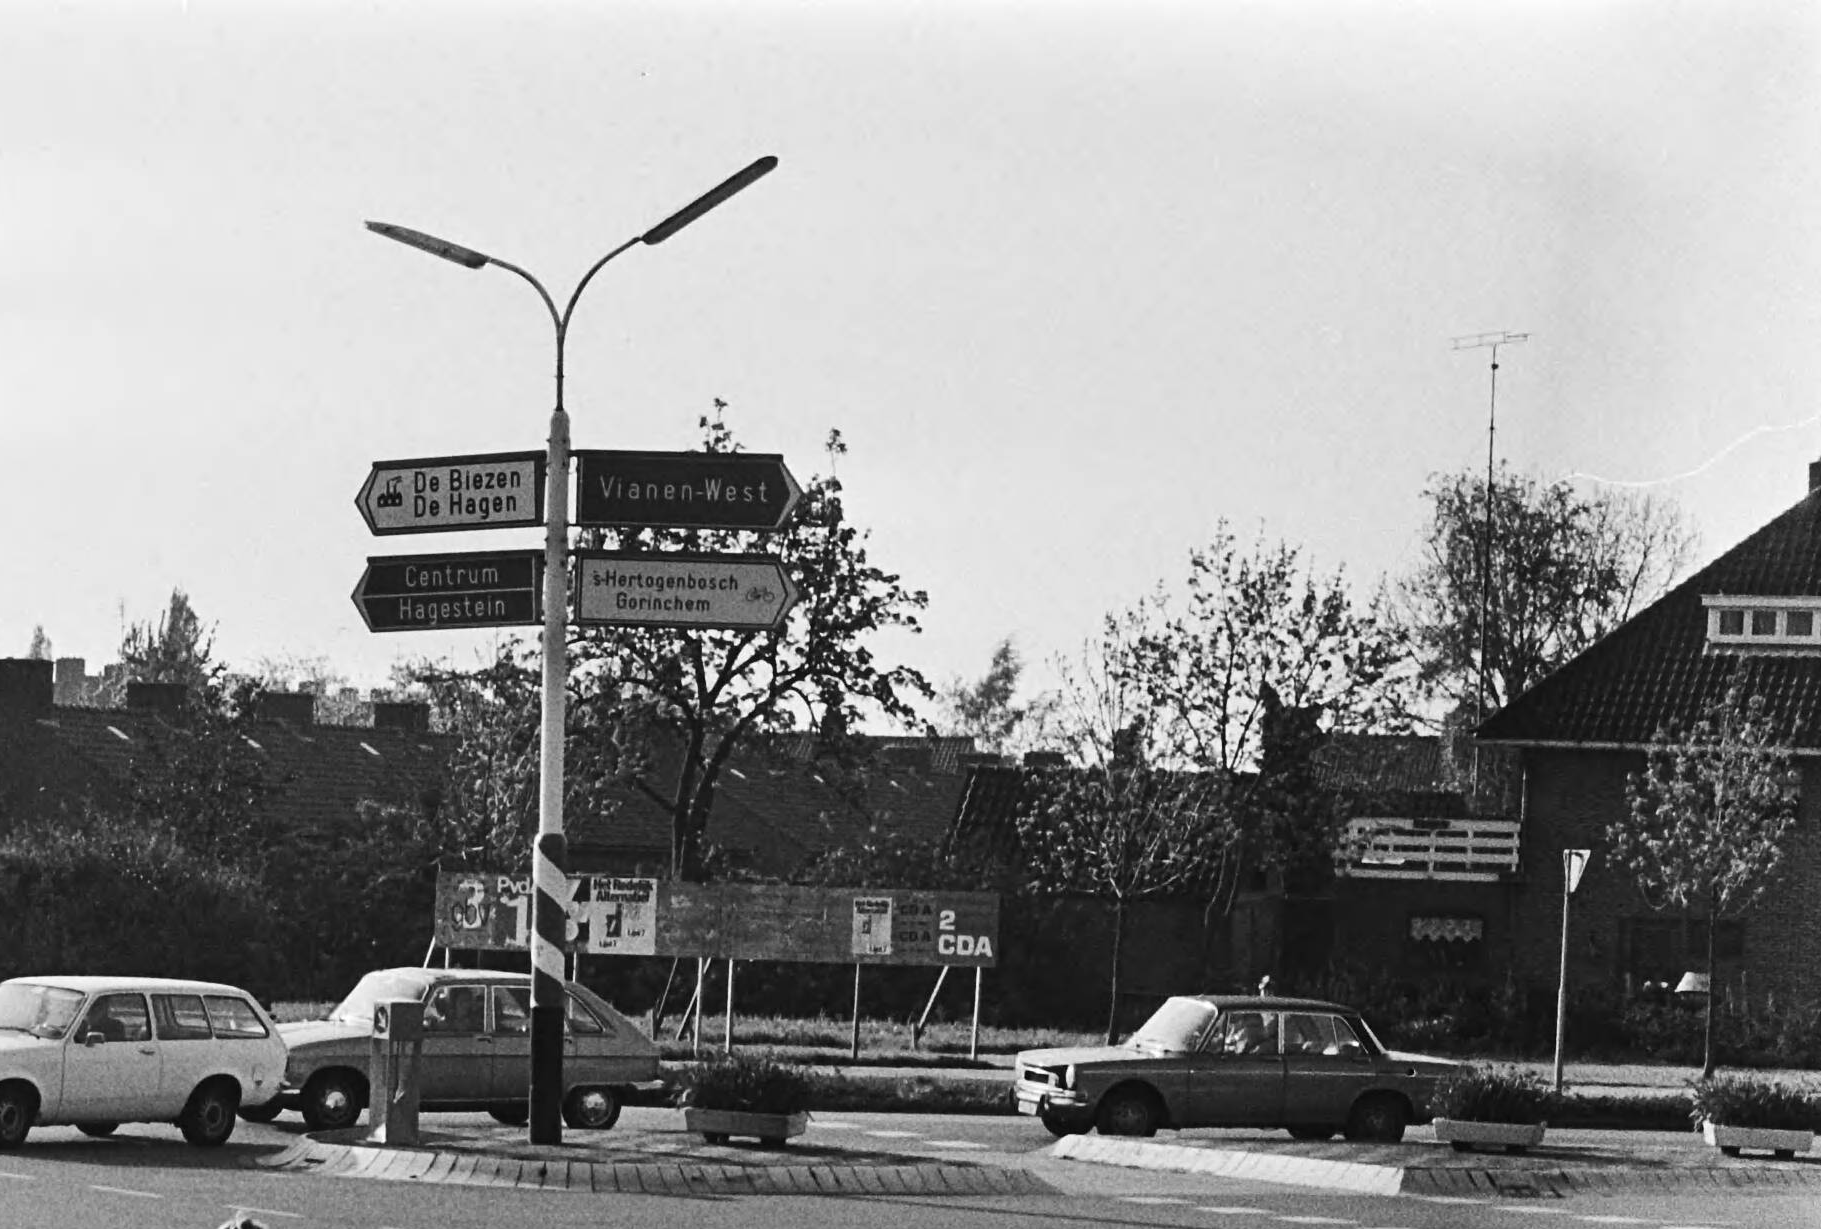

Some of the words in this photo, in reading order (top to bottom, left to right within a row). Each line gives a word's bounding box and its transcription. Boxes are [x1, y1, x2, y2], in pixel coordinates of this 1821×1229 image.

[414, 471, 440, 494] De
[449, 468, 522, 491] Biezen
[599, 474, 768, 502] Vianen-West
[414, 494, 440, 518] De
[449, 492, 517, 519] Hagen
[404, 564, 499, 587] Centrum
[398, 595, 506, 625] Hagestein
[615, 591, 711, 612] Gorinchem
[497, 875, 534, 895] Pvd
[499, 895, 528, 946] 1
[939, 910, 956, 930] 2
[938, 934, 993, 957] CDA
